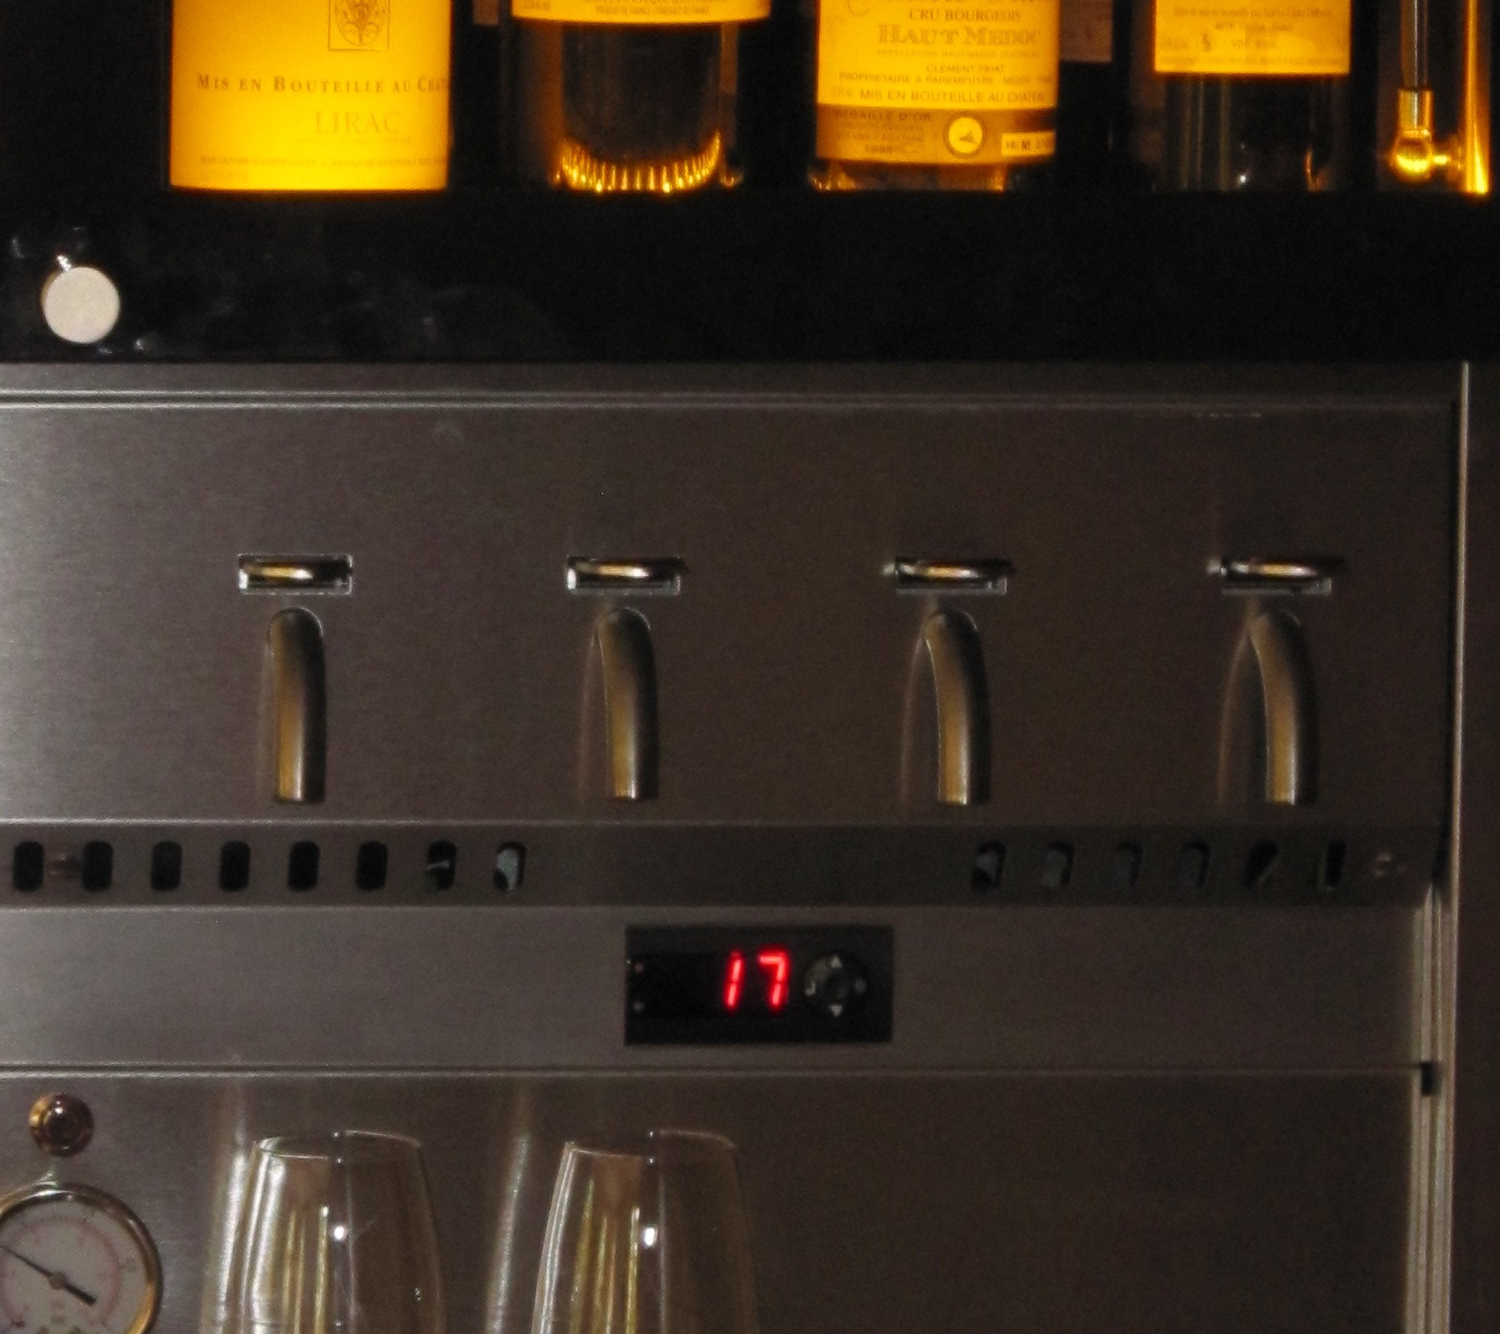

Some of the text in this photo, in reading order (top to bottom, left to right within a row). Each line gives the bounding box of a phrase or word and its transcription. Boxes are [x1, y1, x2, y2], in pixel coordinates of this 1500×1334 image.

[878, 23, 958, 45] HAUT
[197, 72, 230, 93] MIS
[239, 76, 263, 93] EN
[273, 73, 385, 94] BOUTEILLE
[313, 110, 402, 136] LIRAC
[726, 951, 788, 1008] 17
